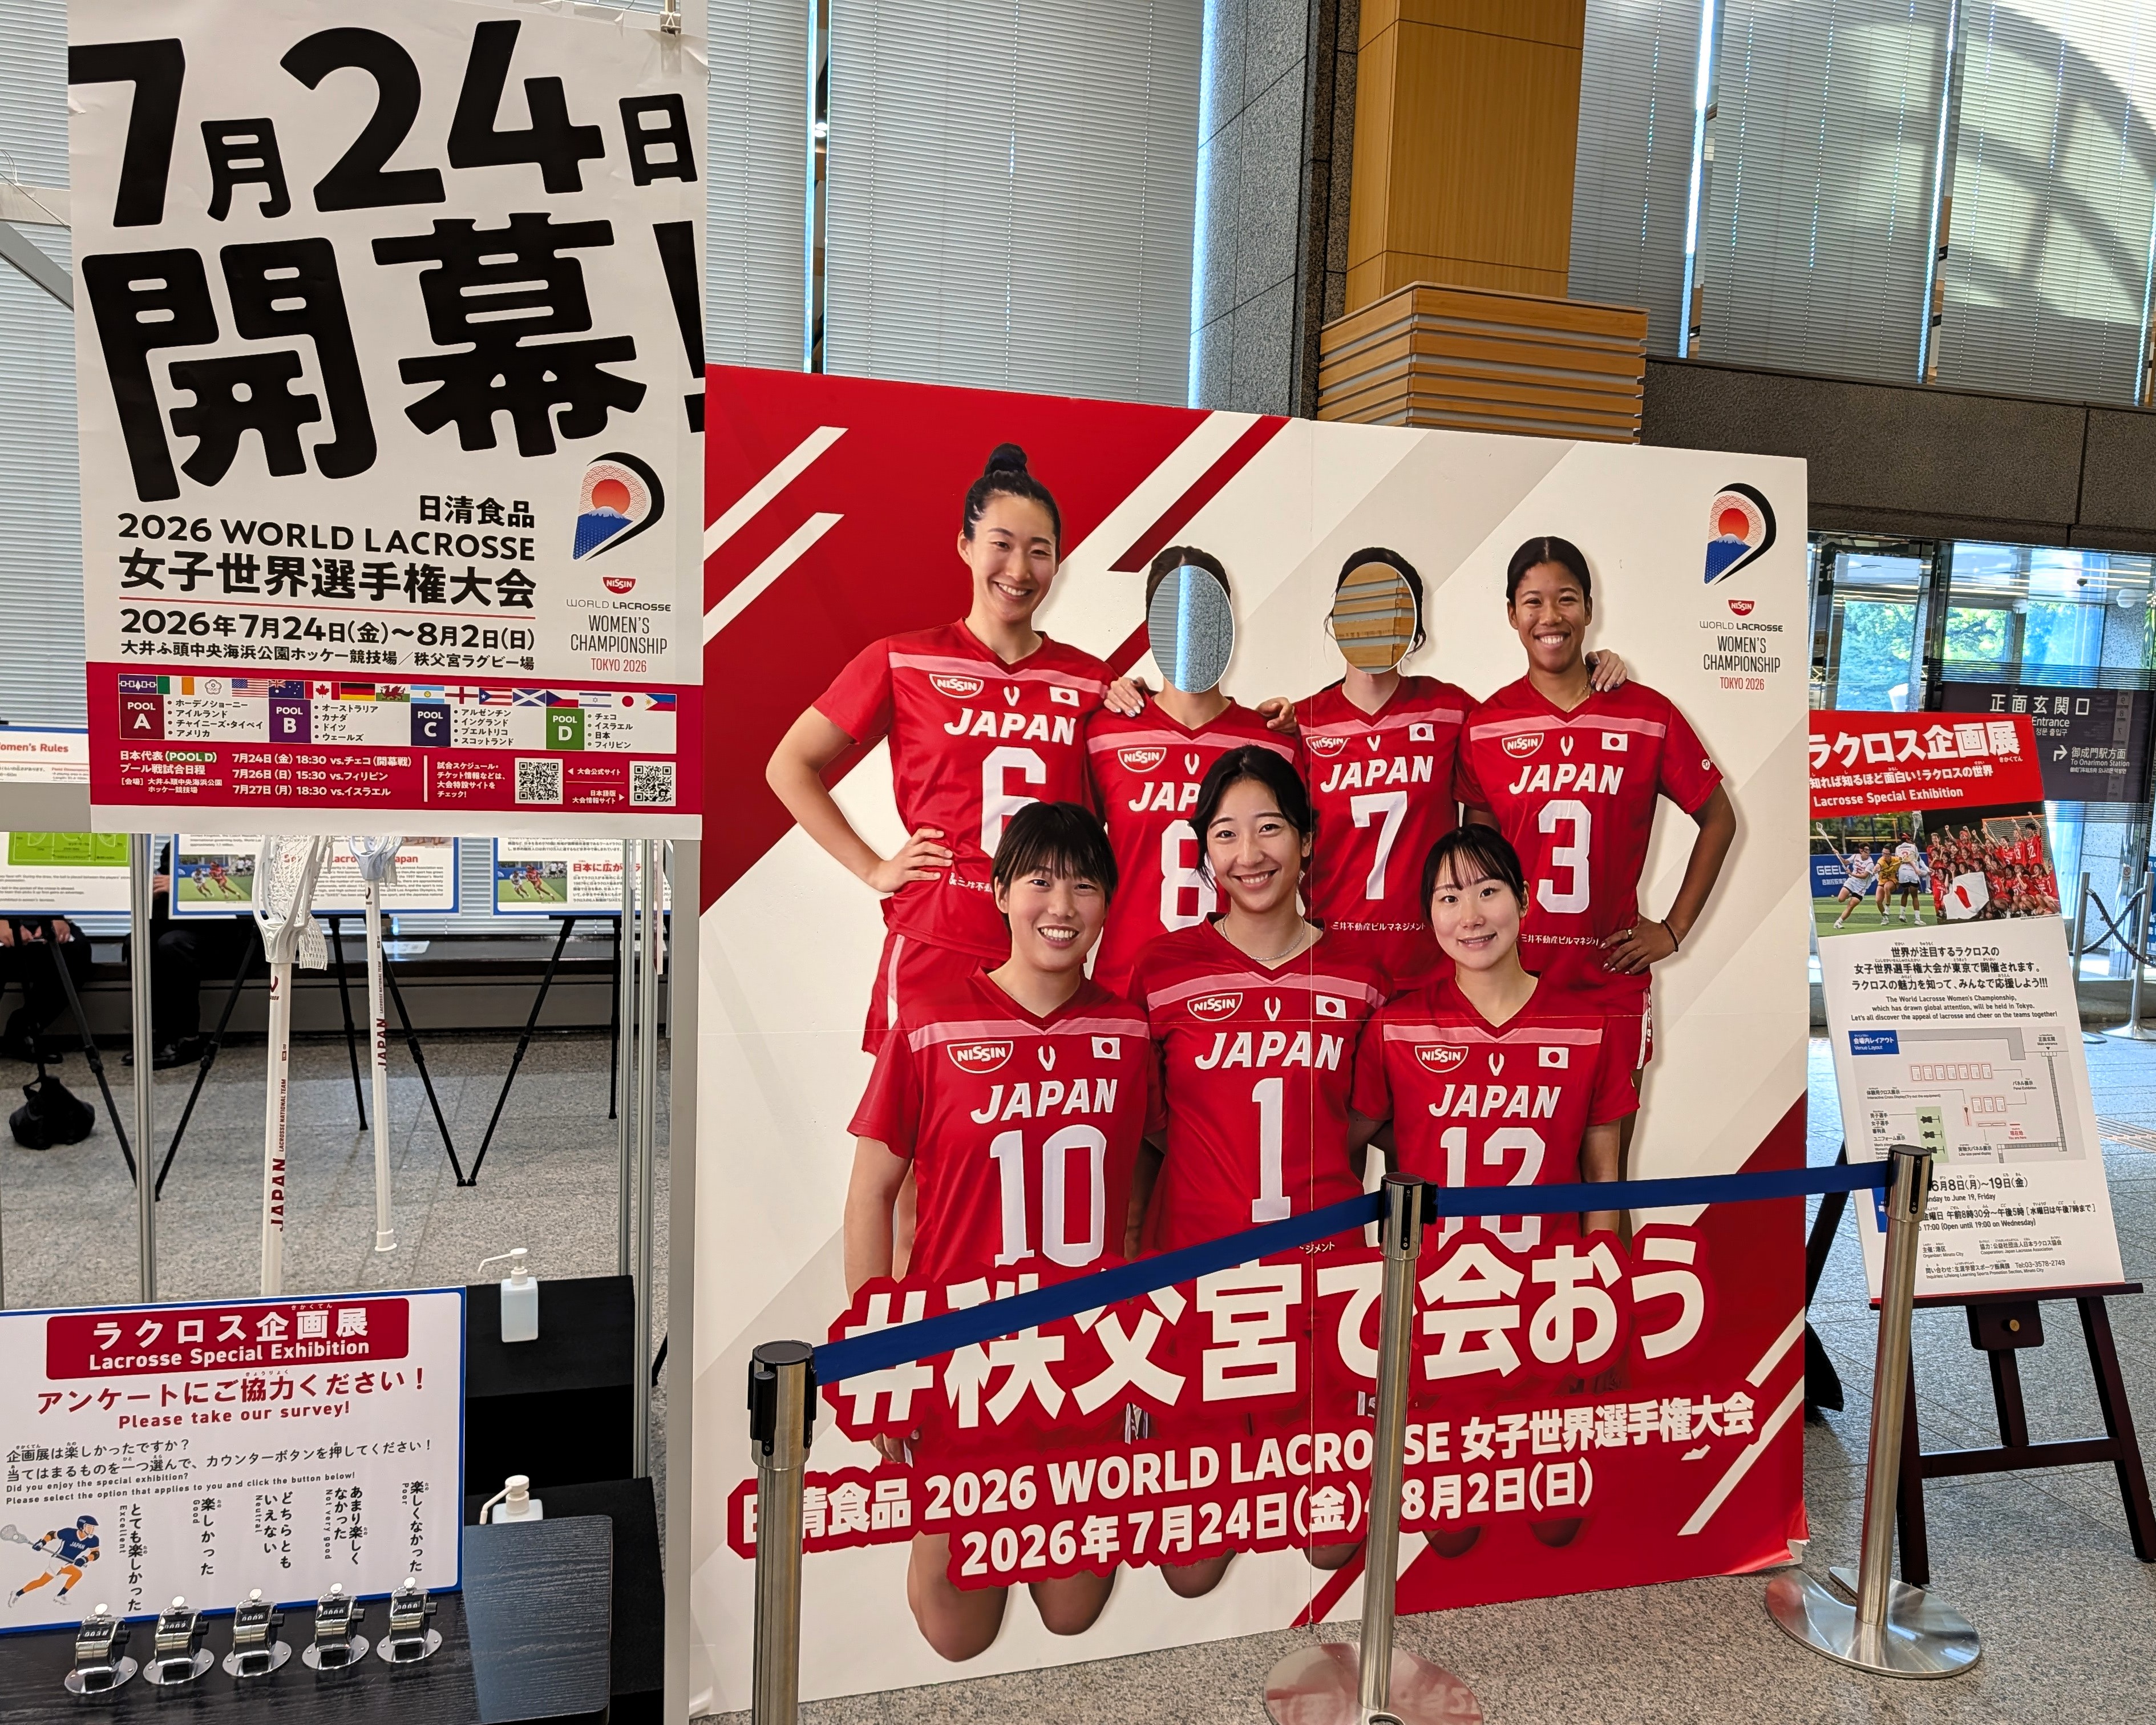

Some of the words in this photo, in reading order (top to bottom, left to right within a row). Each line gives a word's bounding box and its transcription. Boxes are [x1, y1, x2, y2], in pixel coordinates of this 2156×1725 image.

[68, 21, 697, 227] 7月24日
[420, 495, 535, 528] 日清食品
[118, 513, 212, 542] 2026
[220, 519, 353, 550] WORLD
[365, 528, 535, 561] LACROSSE
[119, 547, 536, 609] 女子世界選手権大会
[606, 579, 633, 589] NISSIN
[567, 599, 609, 609] WORLD
[612, 601, 671, 612] LACROSSE
[588, 615, 650, 633] WOMEN'S
[1700, 621, 1734, 629] WORLD
[1736, 623, 1783, 632] LACROSSE
[571, 634, 668, 655] CHAMPIONSHIP
[1717, 635, 1766, 653] WOMEN'S
[591, 658, 620, 672] TOKYO
[623, 659, 646, 672] 2026
[1704, 654, 1780, 673] CHAMPIONSHIP
[937, 678, 978, 692] NISSIN
[1720, 677, 1743, 689] TOKYO
[1746, 678, 1765, 690] 2026
[176, 700, 248, 708] ホーデノショーニー
[276, 706, 303, 715] POOL
[322, 704, 378, 713] オーストラリア
[461, 708, 511, 717] アルゼンチン
[1990, 694, 2090, 715] 正面玄関口
[134, 713, 151, 729] A
[322, 713, 348, 722] カナダ
[418, 710, 443, 719] POOL
[461, 718, 509, 727] イングランド
[552, 715, 577, 724] POOL
[2032, 717, 2070, 728] Entrance
[284, 718, 297, 733] B
[323, 723, 346, 732] ドイツ
[424, 722, 437, 737] C
[462, 728, 508, 736] プエルトリコ
[559, 726, 572, 741] D
[944, 708, 1075, 745] JAPAN
[322, 733, 364, 742] ウェールズ
[461, 737, 513, 746] スコットランド
[1507, 737, 1539, 751] NISSIN
[1809, 721, 2020, 769] ラクロス企画展
[296, 755, 326, 765] 18:30
[1123, 750, 1160, 763] NISSIN
[2072, 748, 2126, 759] 御成門駅方面
[120, 763, 205, 775] プール戦試合日程
[296, 771, 326, 780] 15:30
[1320, 756, 1433, 793] JAPAN
[1509, 764, 1624, 795] JAPAN
[296, 786, 327, 796] 18:30
[1813, 794, 1863, 808] Lacrosse
[1867, 790, 1906, 805] Special
[1909, 787, 1963, 800] Exhibition
[981, 746, 1046, 857] 6
[1350, 791, 1407, 900] 7
[1537, 800, 1591, 914] 3
[1194, 997, 1235, 1012] NISSIN
[377, 1018, 387, 1071] JAPAN
[957, 1045, 1005, 1062] NISSIN
[1195, 1031, 1344, 1070] JAPAN
[1422, 1049, 1461, 1063] NISSIN
[970, 1079, 1117, 1124] JAPAN
[1429, 1084, 1561, 1118] JAPAN
[1252, 1077, 1291, 1223] 1
[271, 1158, 285, 1232] JAPAN
[990, 1124, 1107, 1268] 10
[1438, 1127, 1545, 1254] 12
[93, 1307, 368, 1348] ラクロス企画展
[90, 1354, 181, 1371] Lacrosse
[190, 1346, 262, 1368] Special
[271, 1338, 369, 1359] Exhibition
[119, 1414, 183, 1429] Please
[192, 1409, 232, 1424] take
[240, 1408, 272, 1420] our
[280, 1401, 350, 1419] survey!
[925, 1466, 1036, 1521] 2026
[1047, 1446, 1219, 1505] WORLD
[1231, 1421, 1450, 1485] LACROSE
[1462, 1392, 1754, 1463] 女子世界選手権大会
[6, 1496, 39, 1505] Please
[44, 1493, 74, 1502] select
[98, 1490, 127, 1498] option
[155, 1485, 189, 1495] applies
[247, 1478, 269, 1487] click
[292, 1474, 321, 1483] button
[325, 1472, 355, 1480] below!
[47, 1482, 73, 1490] enjoy
[96, 1477, 132, 1487] special
[136, 1473, 188, 1483] exhibition?
[334, 1488, 348, 1540] なかった
[264, 1496, 277, 1553] いえない
[280, 1491, 292, 1569] どちらとも
[349, 1486, 363, 1565] あまり楽しく
[410, 1481, 424, 1572] 楽しくなかった
[201, 1498, 215, 1575] 楽しかった
[128, 1504, 143, 1611] とても楽しかった
